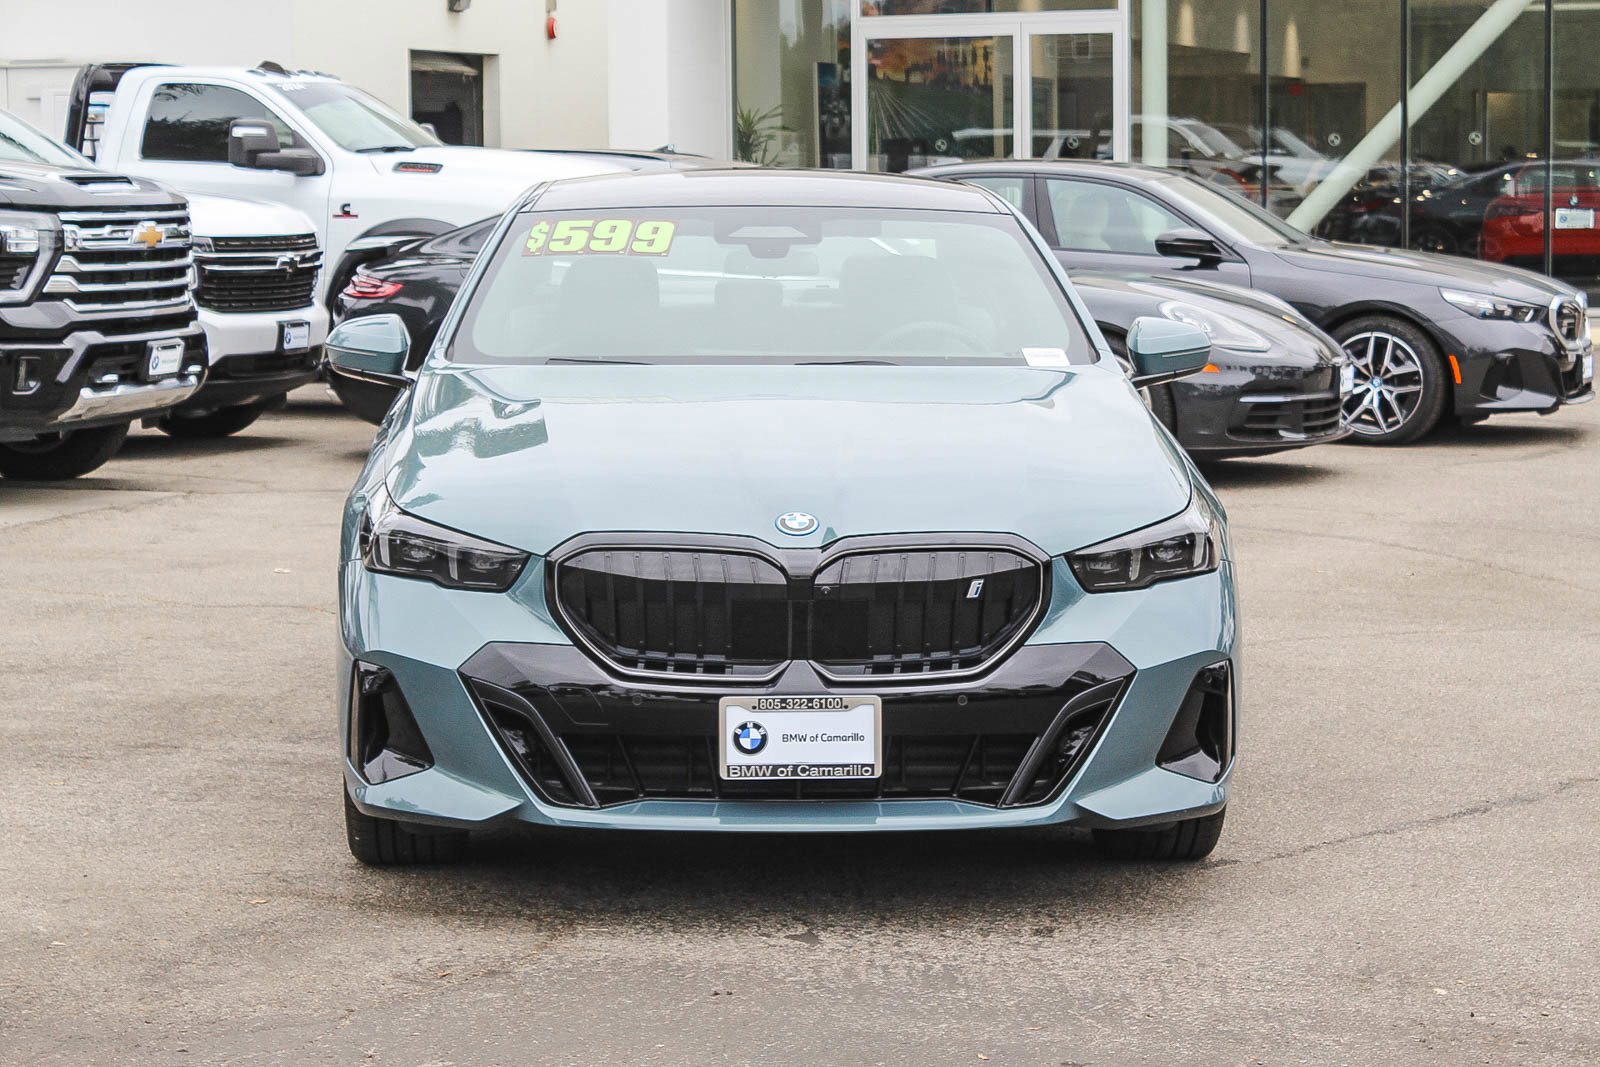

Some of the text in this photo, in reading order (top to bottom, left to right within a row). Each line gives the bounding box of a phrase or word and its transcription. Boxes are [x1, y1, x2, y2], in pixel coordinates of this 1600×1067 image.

[526, 219, 675, 253] $599
[759, 698, 842, 710] 805-322-6100
[781, 732, 865, 743] BMW of Camarillo
[729, 764, 873, 777] BMW of Camarillo
